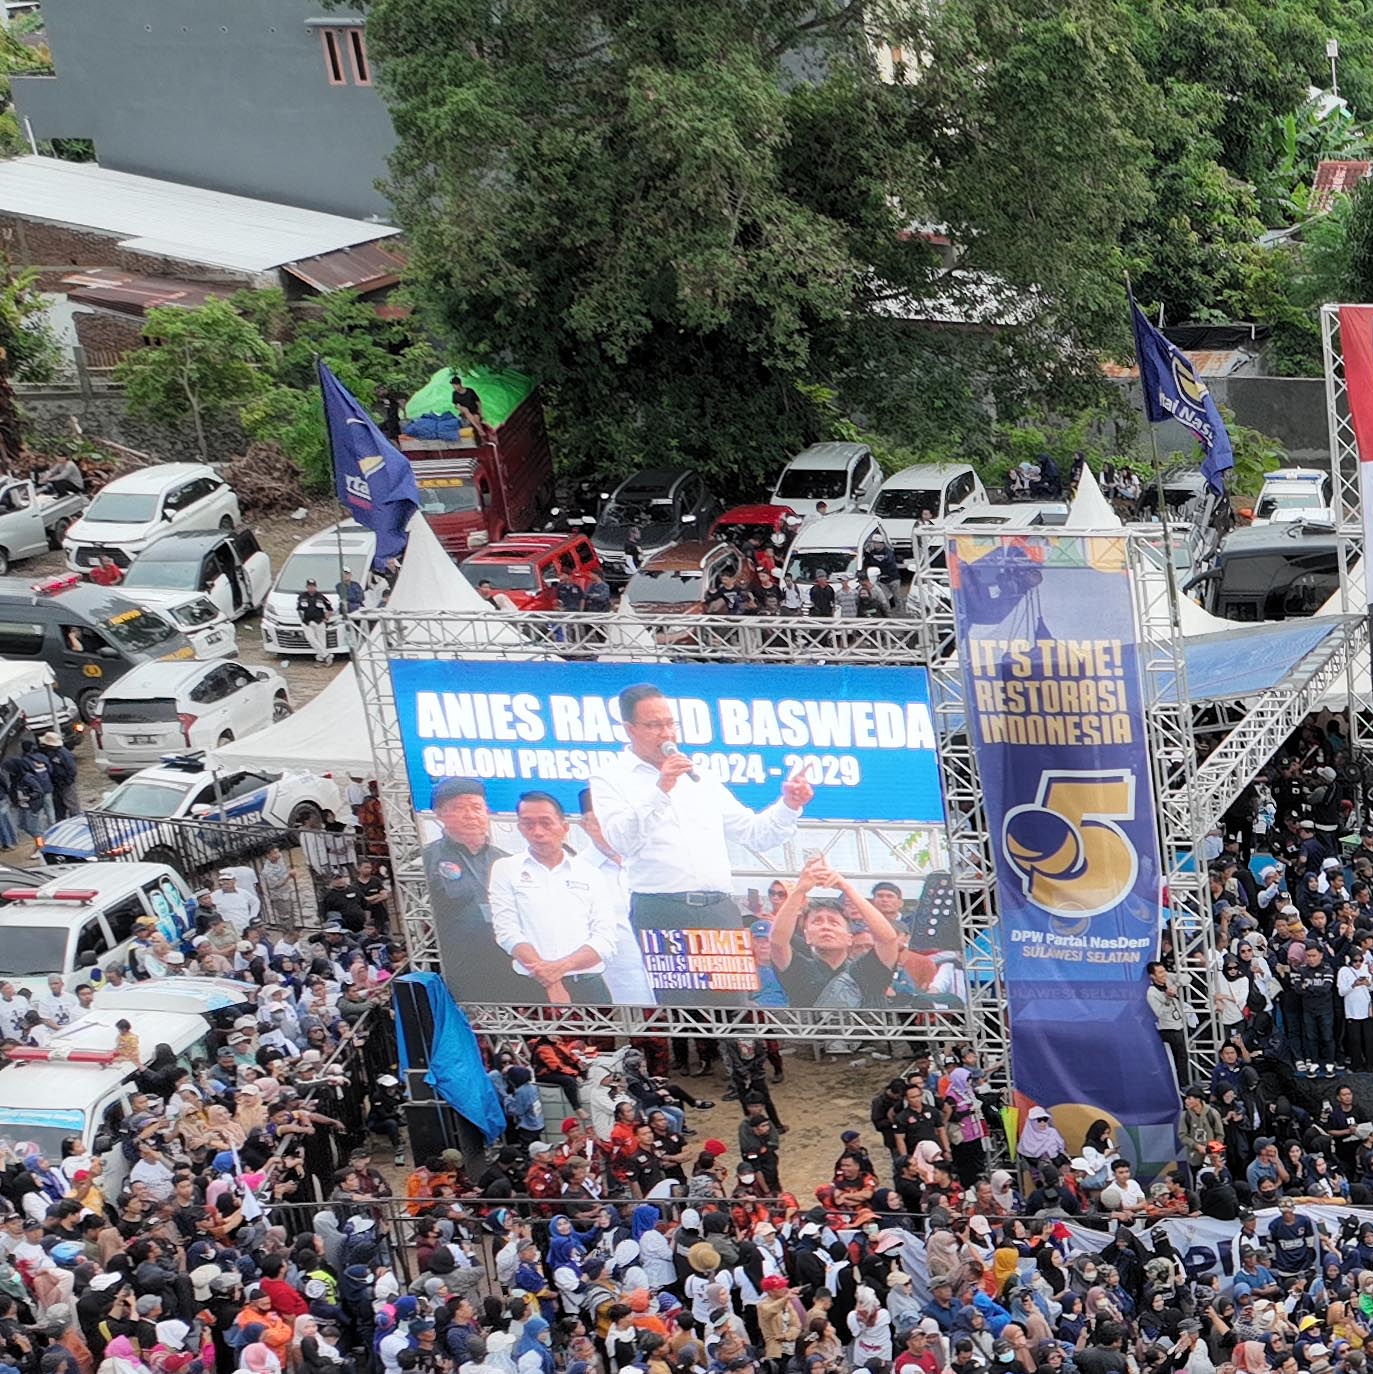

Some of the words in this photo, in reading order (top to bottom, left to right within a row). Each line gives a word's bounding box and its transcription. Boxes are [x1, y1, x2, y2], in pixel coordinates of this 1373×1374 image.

[970, 639, 1031, 679] IT'S
[1034, 639, 1123, 678] TIME!
[974, 679, 1128, 715] RESTORASI
[415, 691, 545, 742] ANIES
[979, 714, 1133, 745] INDONESIA
[423, 745, 508, 779] CALON
[1011, 928, 1043, 945] DPW
[1046, 933, 1087, 948] Partai
[1090, 934, 1149, 949] NasDem
[1022, 945, 1083, 962] SULAWESI
[1086, 949, 1140, 964] SELATAN
